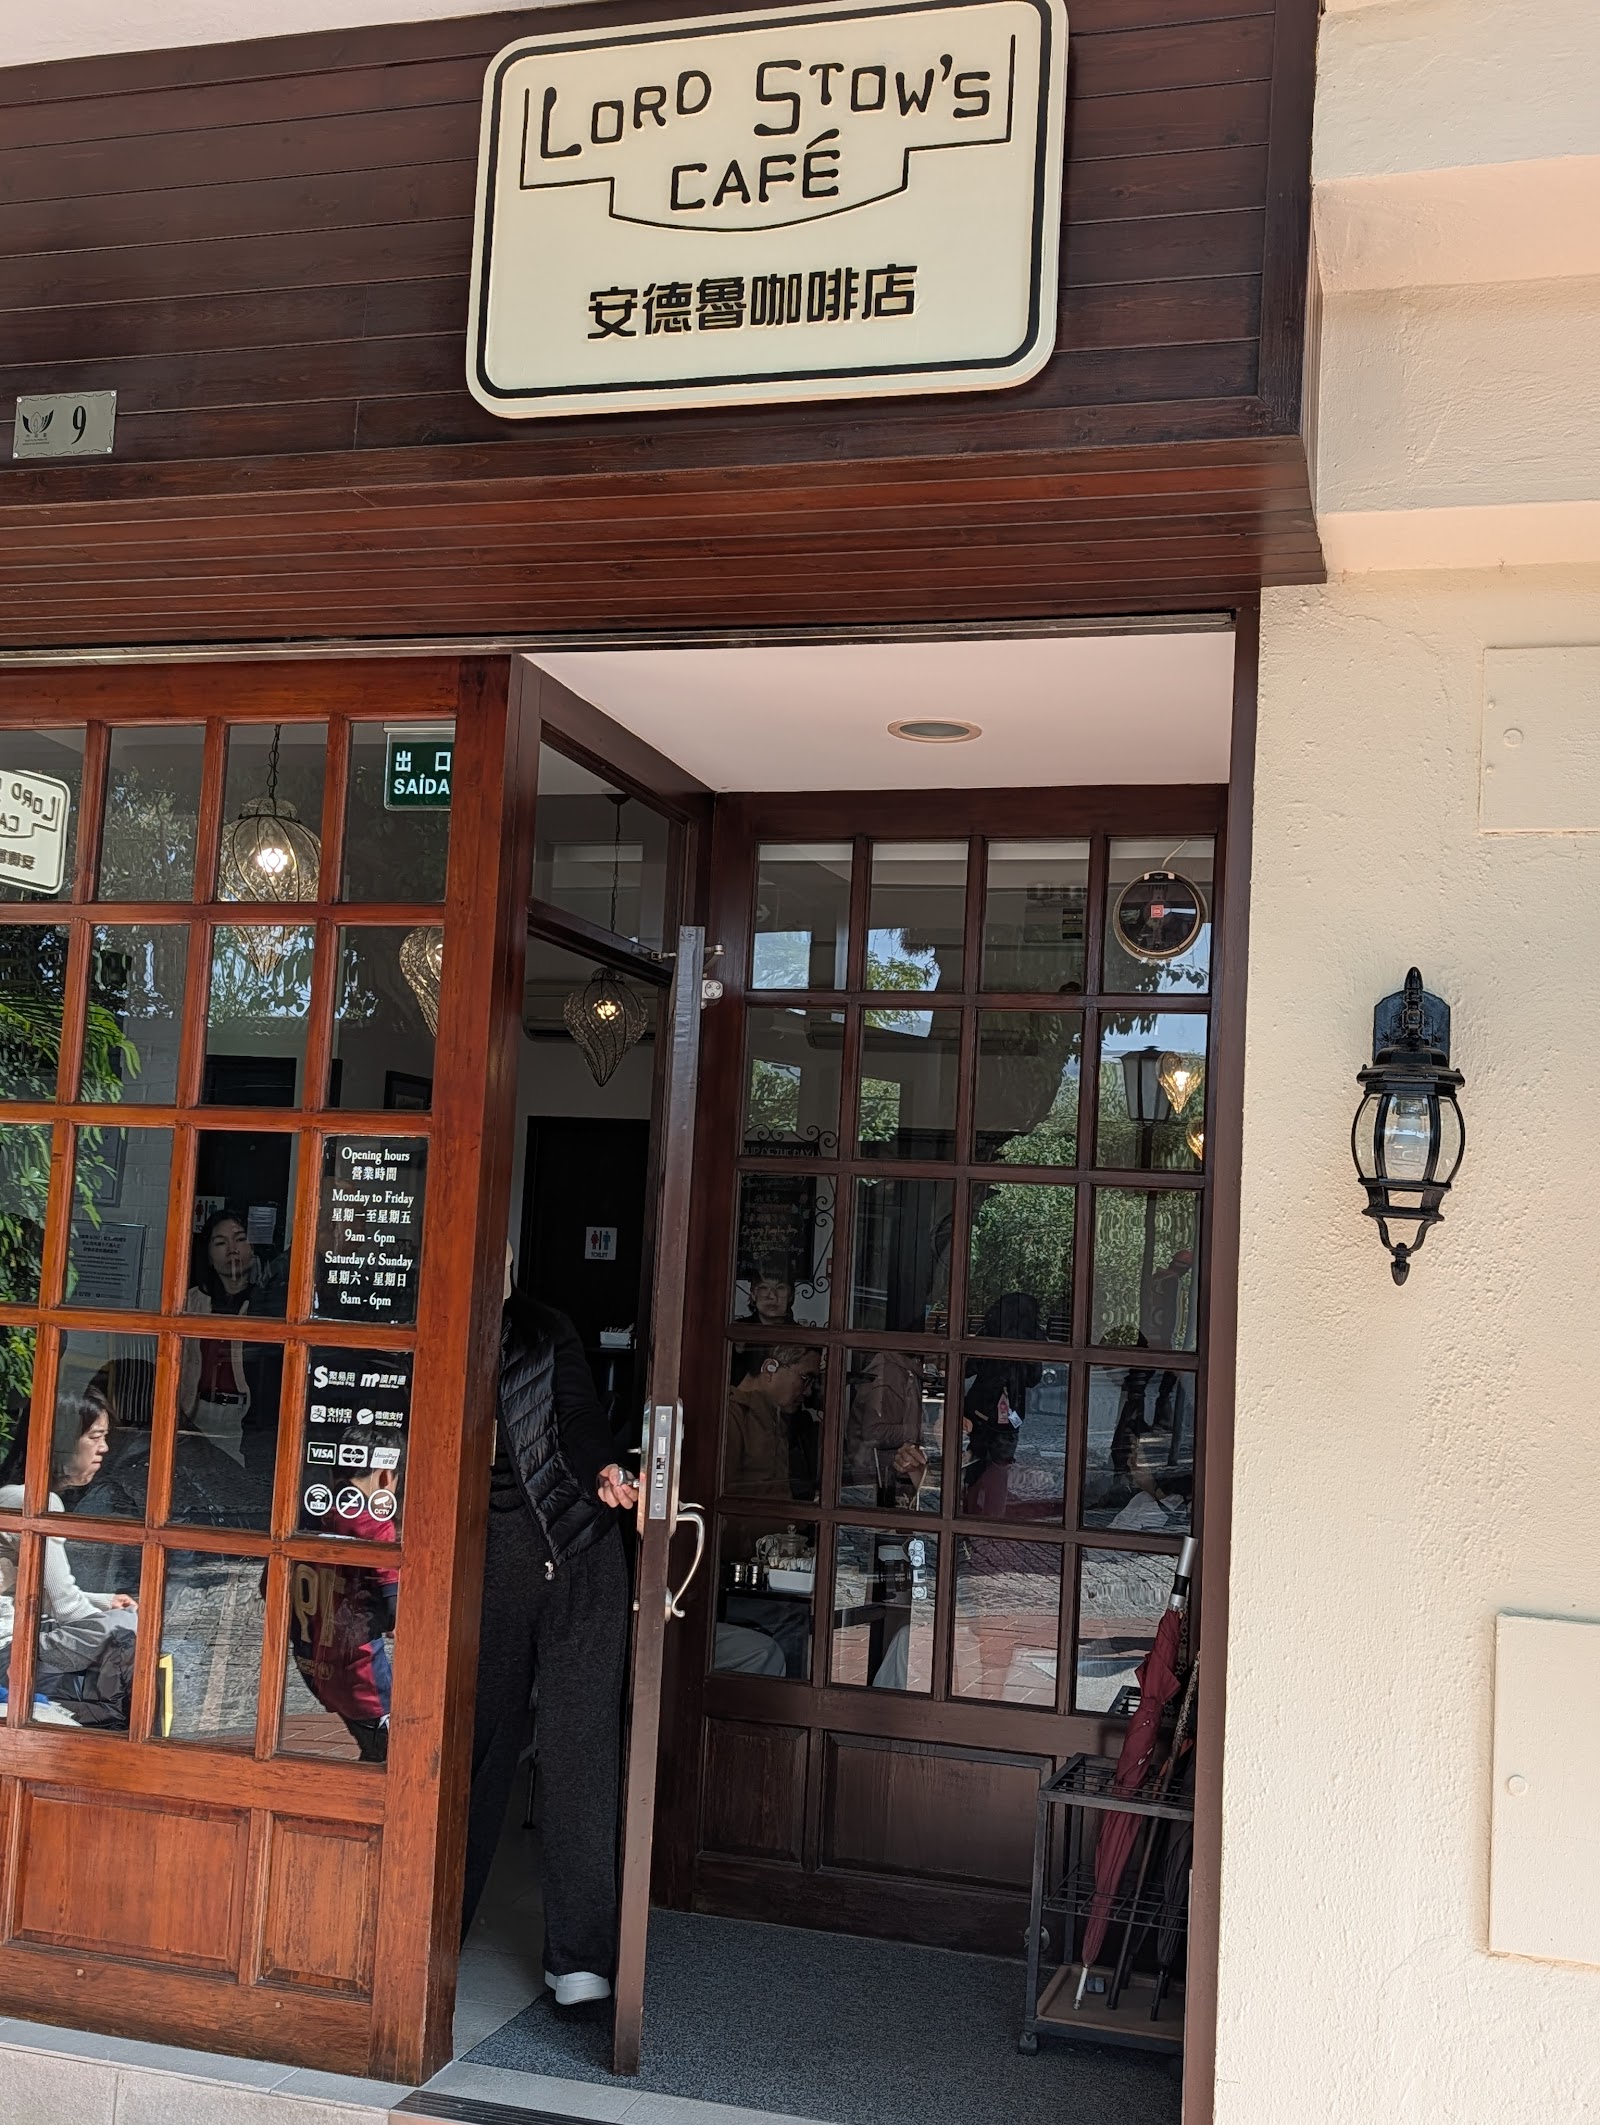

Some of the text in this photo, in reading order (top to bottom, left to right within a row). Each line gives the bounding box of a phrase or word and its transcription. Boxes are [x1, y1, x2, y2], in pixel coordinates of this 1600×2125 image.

[540, 70, 712, 159] LORD
[670, 129, 842, 212] CAFÉ
[587, 264, 918, 341] 安德魯咖啡店
[71, 405, 87, 446] 9
[395, 750, 451, 772] 出口
[393, 773, 450, 795] SAÍDA
[341, 1147, 410, 1165] Opening hours
[351, 1166, 398, 1181] 營業時間
[332, 1189, 414, 1208] Monday to Friday
[331, 1208, 412, 1224] 星期一至星期五
[344, 1229, 365, 1242] 9am
[373, 1230, 395, 1245] 6pm
[325, 1251, 413, 1271] Saturday & Sunday
[326, 1270, 407, 1287] 星期六、星期日
[340, 1291, 361, 1304] 8am
[369, 1292, 391, 1310] 6pm
[311, 1448, 334, 1459] VISA
